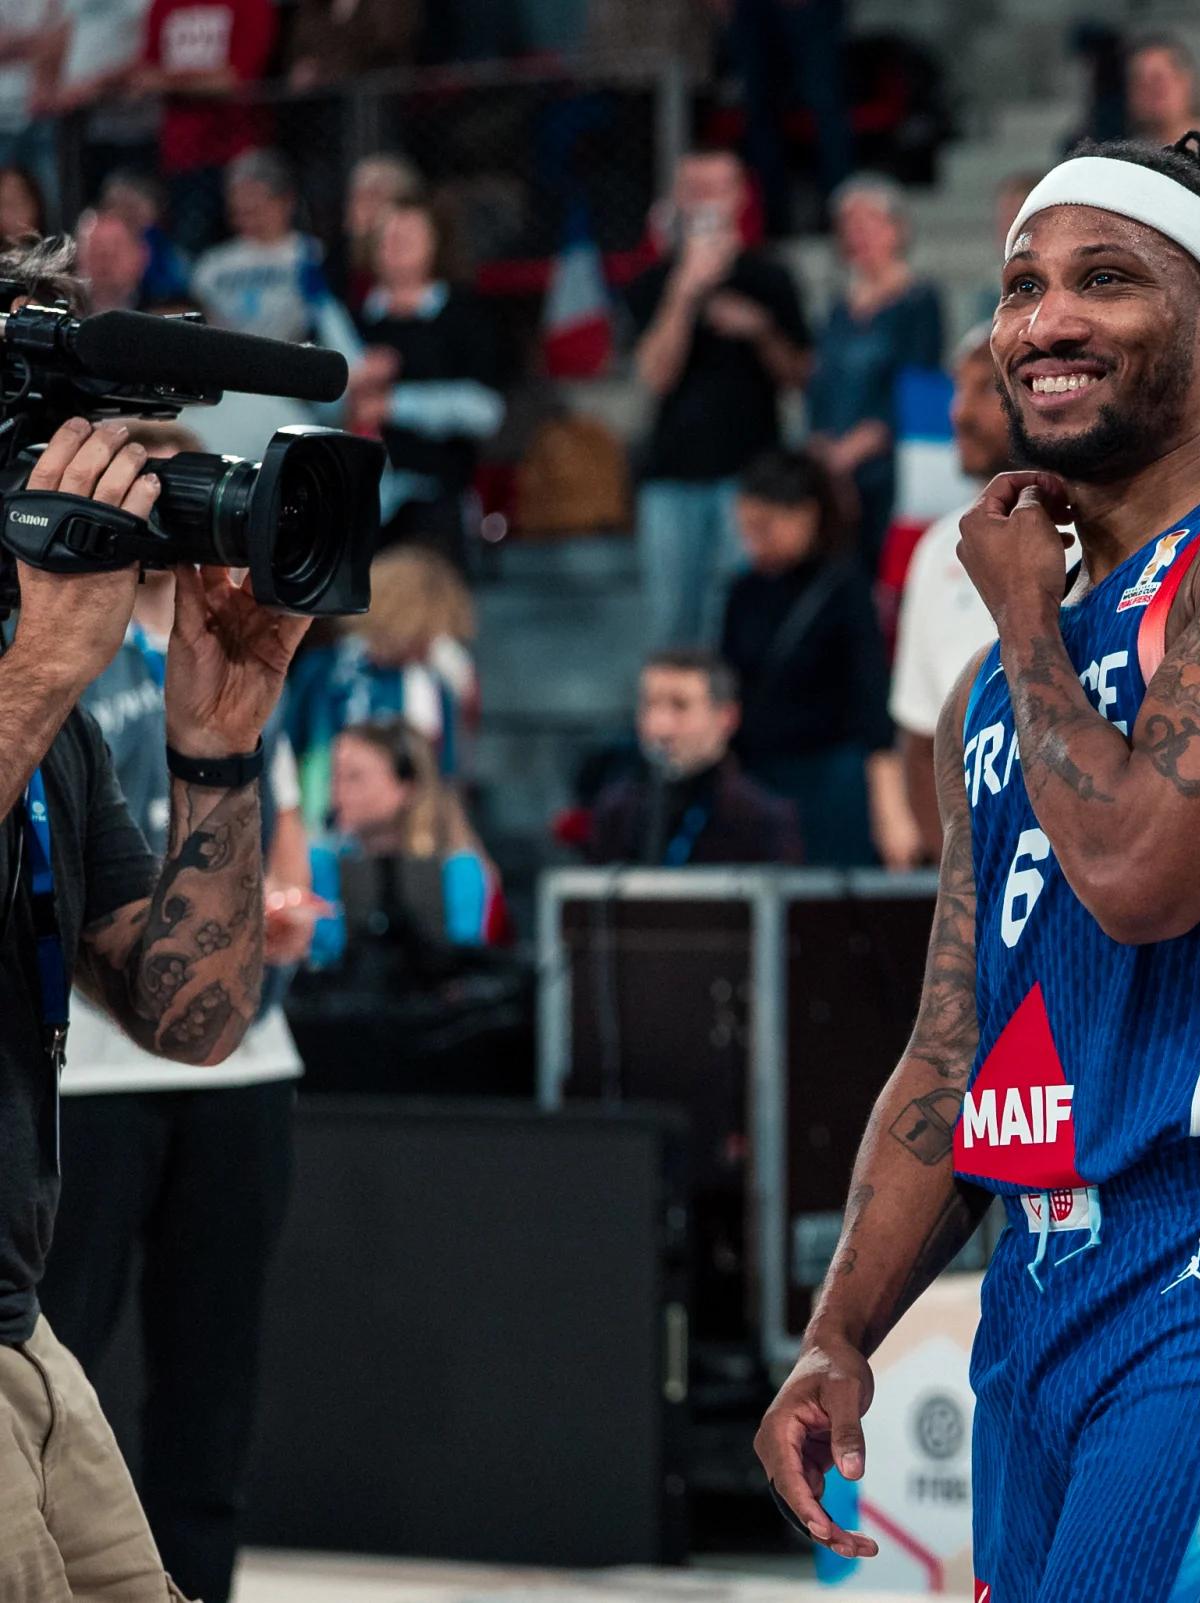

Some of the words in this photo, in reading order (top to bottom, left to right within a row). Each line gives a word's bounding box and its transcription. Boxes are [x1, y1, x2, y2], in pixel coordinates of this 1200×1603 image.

[10, 510, 49, 528] Canon
[1123, 589, 1143, 600] WORLD
[1143, 586, 1157, 595] CUP
[963, 1084, 1075, 1149] MAIF
